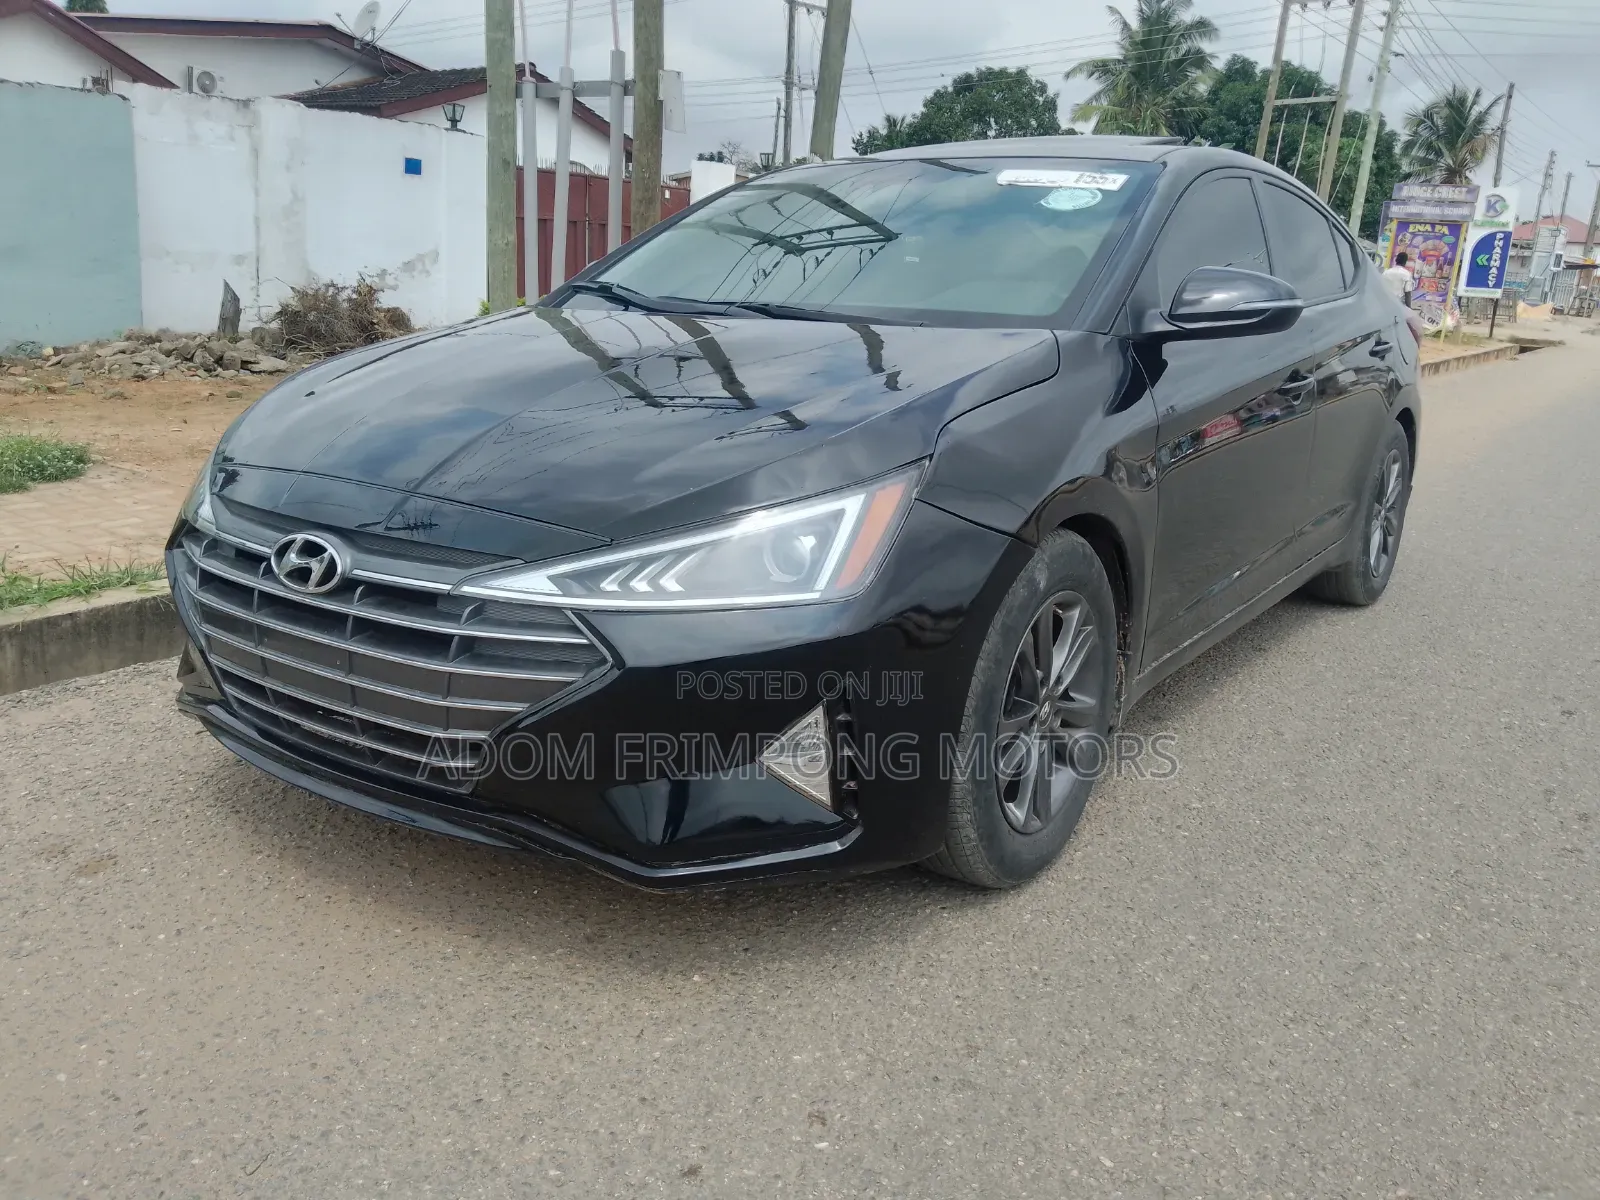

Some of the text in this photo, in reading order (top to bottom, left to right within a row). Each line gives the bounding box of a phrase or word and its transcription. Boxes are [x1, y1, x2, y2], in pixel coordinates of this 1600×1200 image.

[1435, 187, 1469, 198] CREST
[1443, 206, 1471, 216] SCHOOL
[1408, 223, 1432, 233] ENA
[1434, 224, 1450, 236] PA
[1487, 232, 1505, 288] PHARMACY
